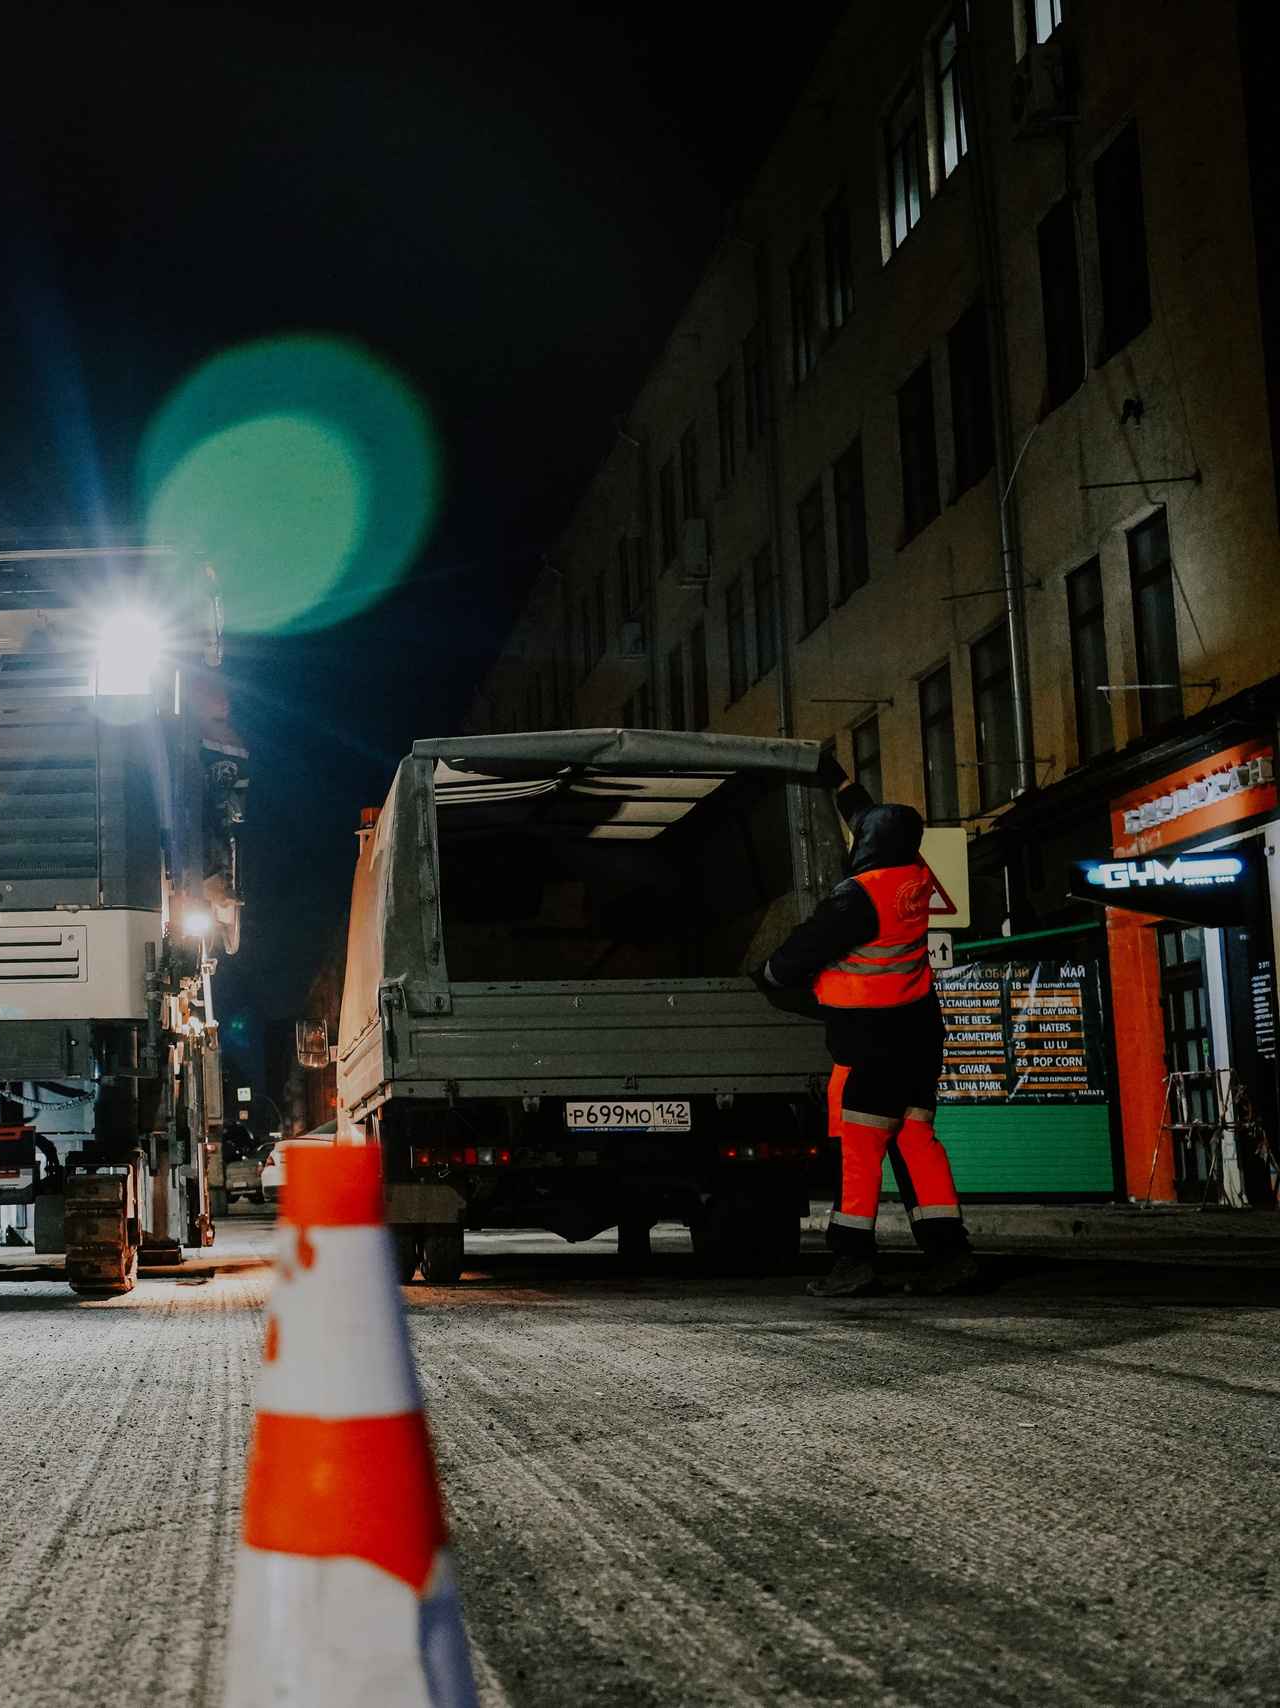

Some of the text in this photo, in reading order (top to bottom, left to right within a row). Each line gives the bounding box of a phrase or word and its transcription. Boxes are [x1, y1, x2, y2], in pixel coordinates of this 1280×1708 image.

[1099, 857, 1183, 889] GYM
[1060, 965, 1086, 978] МАЙ
[945, 982, 967, 990] КОТЫ
[968, 982, 999, 990] PICASSO
[1011, 981, 1021, 990] 18
[946, 999, 981, 1008] СТАНЦИЯ
[982, 998, 1000, 1007] МИР
[1042, 1007, 1057, 1015] DAY
[1057, 1007, 1078, 1015] BAND
[954, 1015, 992, 1024] THE BEES
[1013, 1023, 1071, 1032] 20 HATERS
[948, 1032, 1002, 1041] А-СИМЕТРИЯ
[1015, 1040, 1068, 1049] 25 LU LU
[1016, 1056, 1083, 1067] 26 POP CORN
[959, 1064, 992, 1074] GIVARA
[939, 1081, 1002, 1090] 13 LUNA PARK
[656, 1103, 685, 1119] 142
